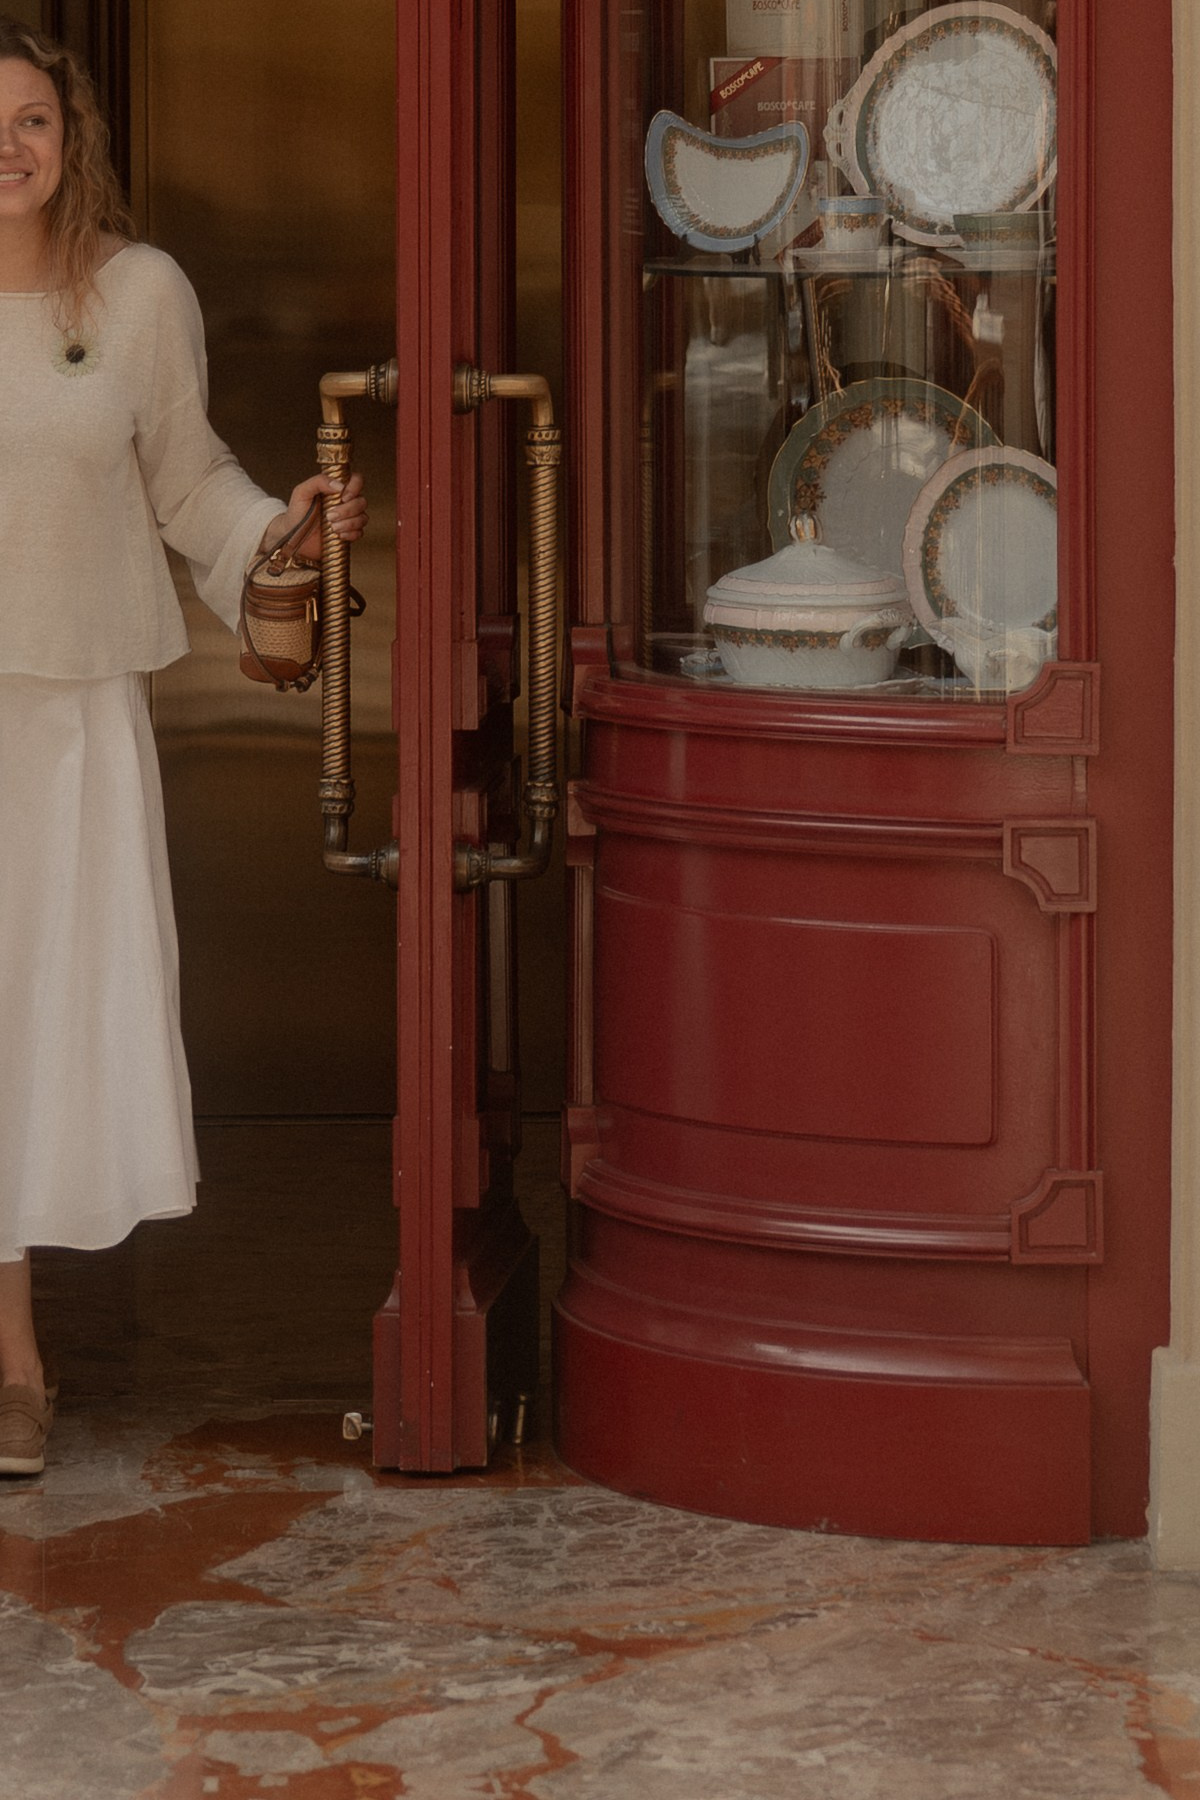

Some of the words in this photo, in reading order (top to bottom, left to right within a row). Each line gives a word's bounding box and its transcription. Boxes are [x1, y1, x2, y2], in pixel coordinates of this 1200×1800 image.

[752, 0, 777, 11] BOSCO
[719, 77, 745, 99] BOSCO
[745, 61, 765, 80] CAFE
[757, 101, 787, 112] BOSCO
[791, 100, 816, 111] CAFE
